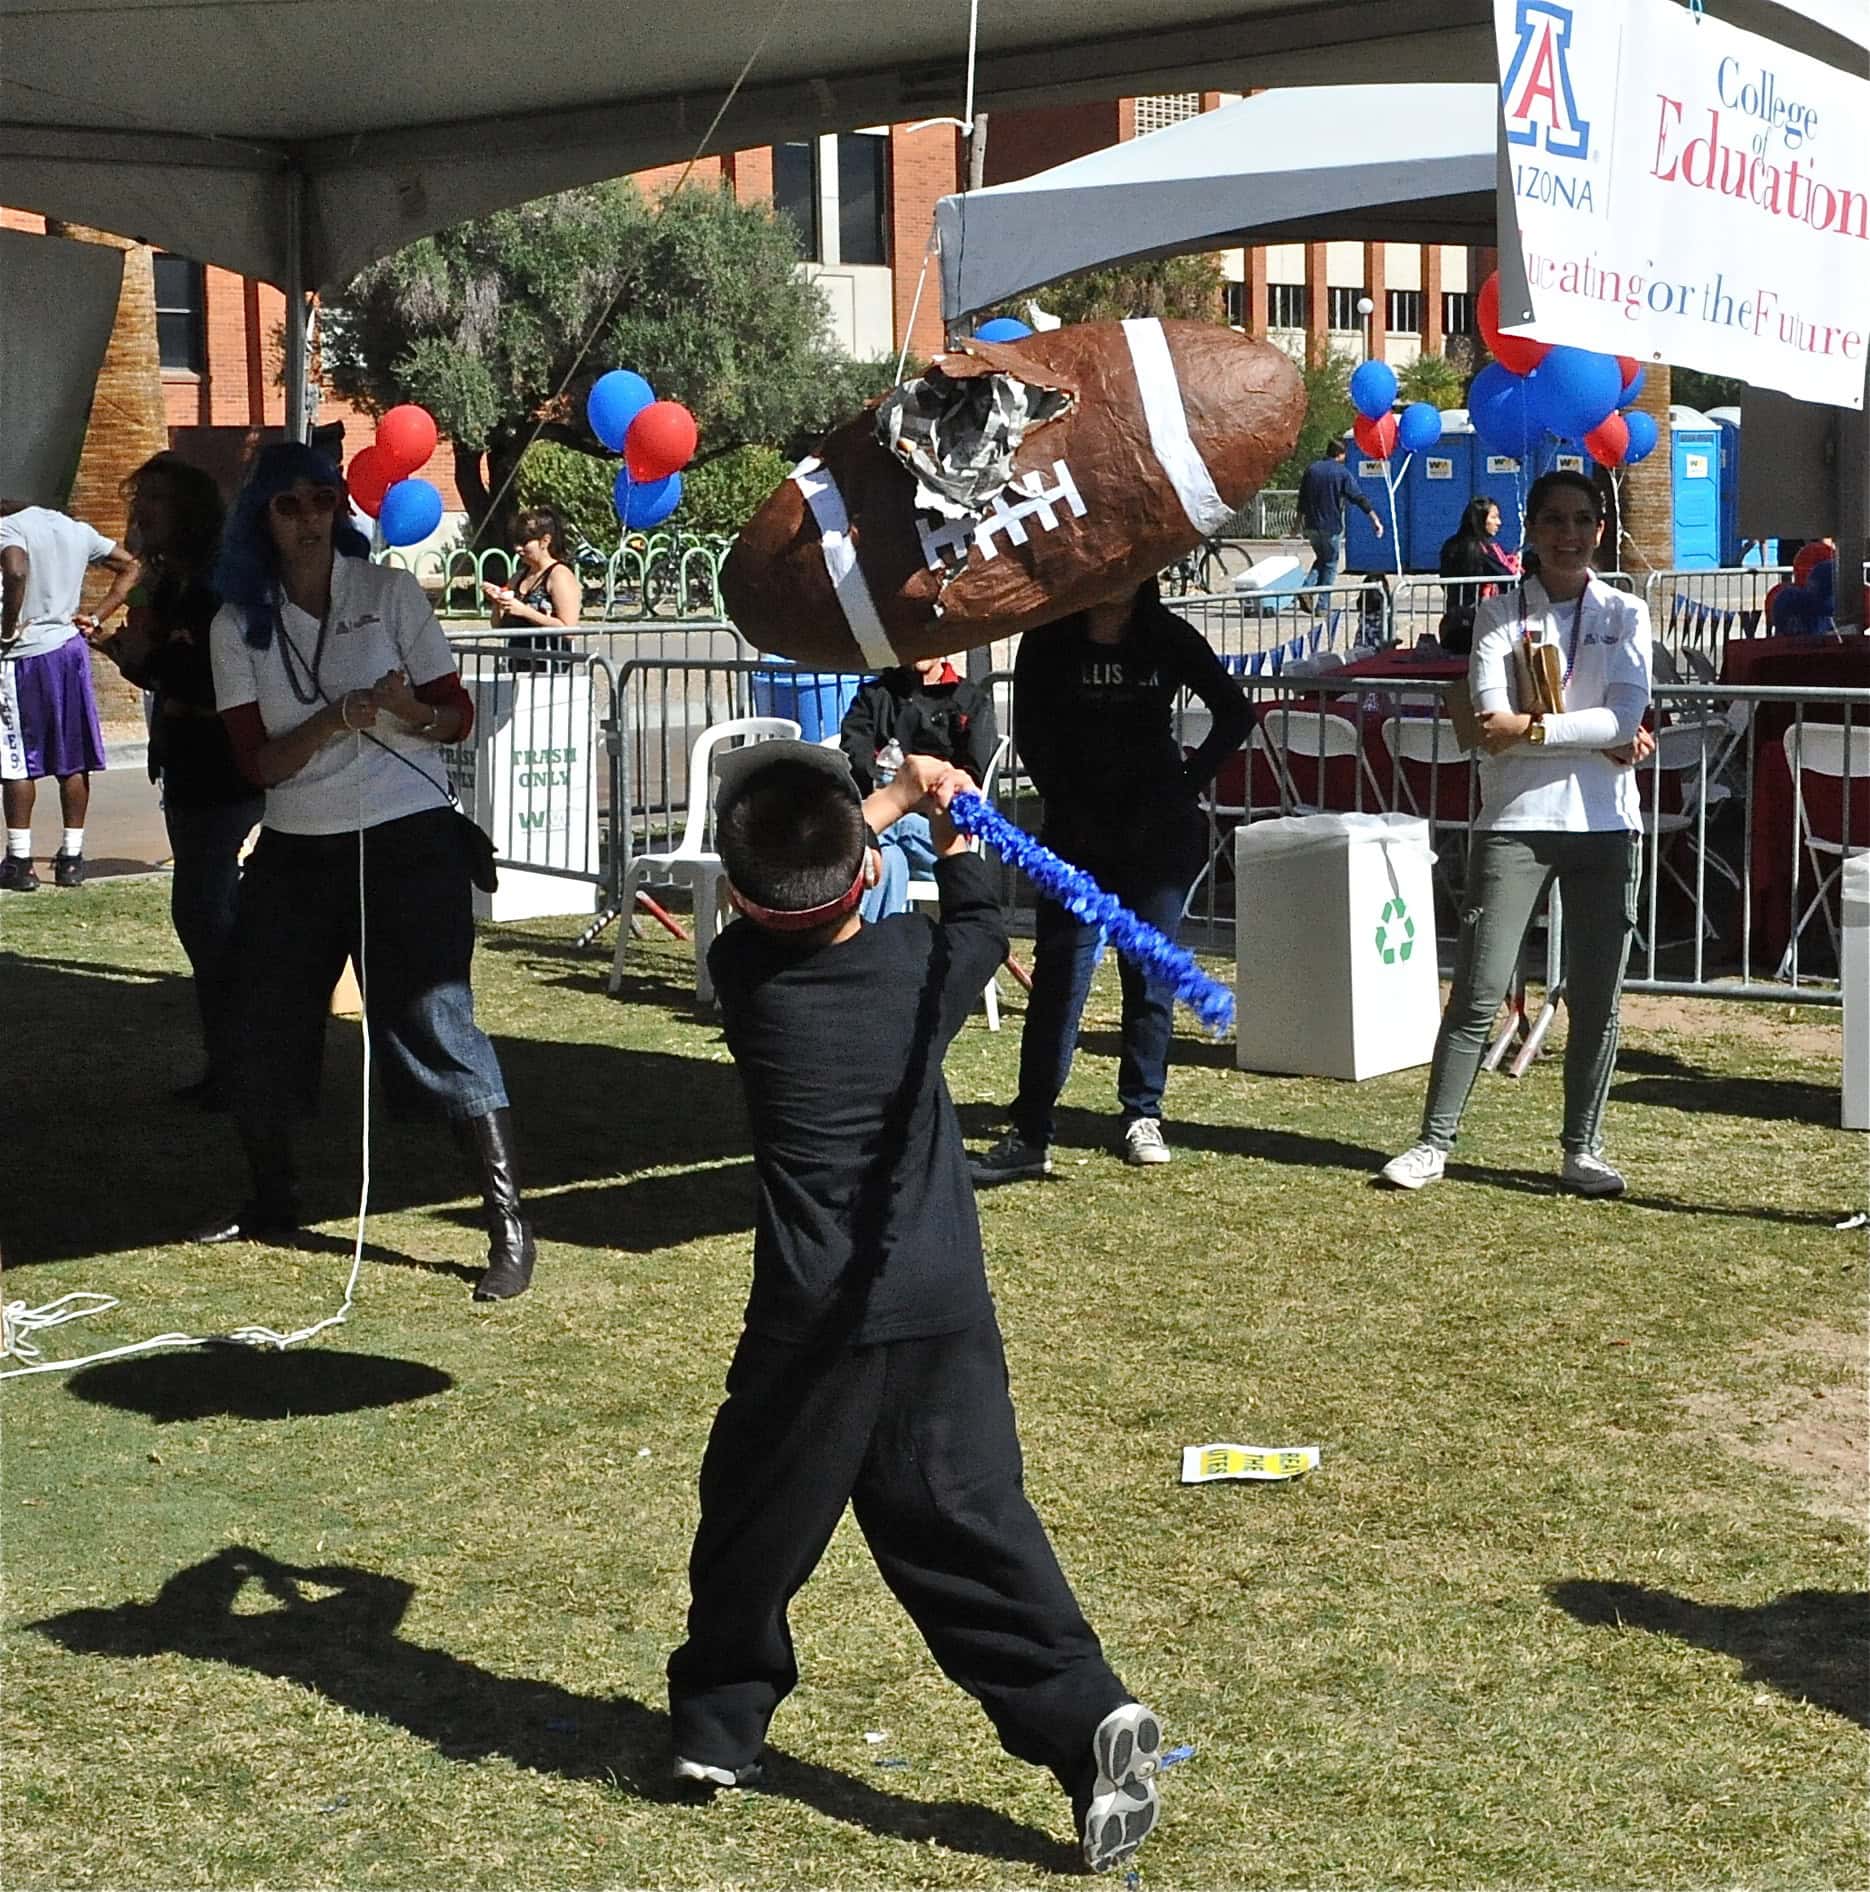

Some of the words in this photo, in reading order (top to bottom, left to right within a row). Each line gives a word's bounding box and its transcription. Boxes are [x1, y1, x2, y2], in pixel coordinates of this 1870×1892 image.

[1717, 56, 1818, 150] College
[1650, 94, 1870, 240] Education
[1752, 126, 1773, 177] of
[1516, 164, 1594, 214] IZONA
[1525, 248, 1647, 321] ucating
[1702, 272, 1752, 330] the
[1754, 289, 1862, 360] Future
[512, 747, 577, 766] TRASH
[518, 770, 570, 788] ONLY
